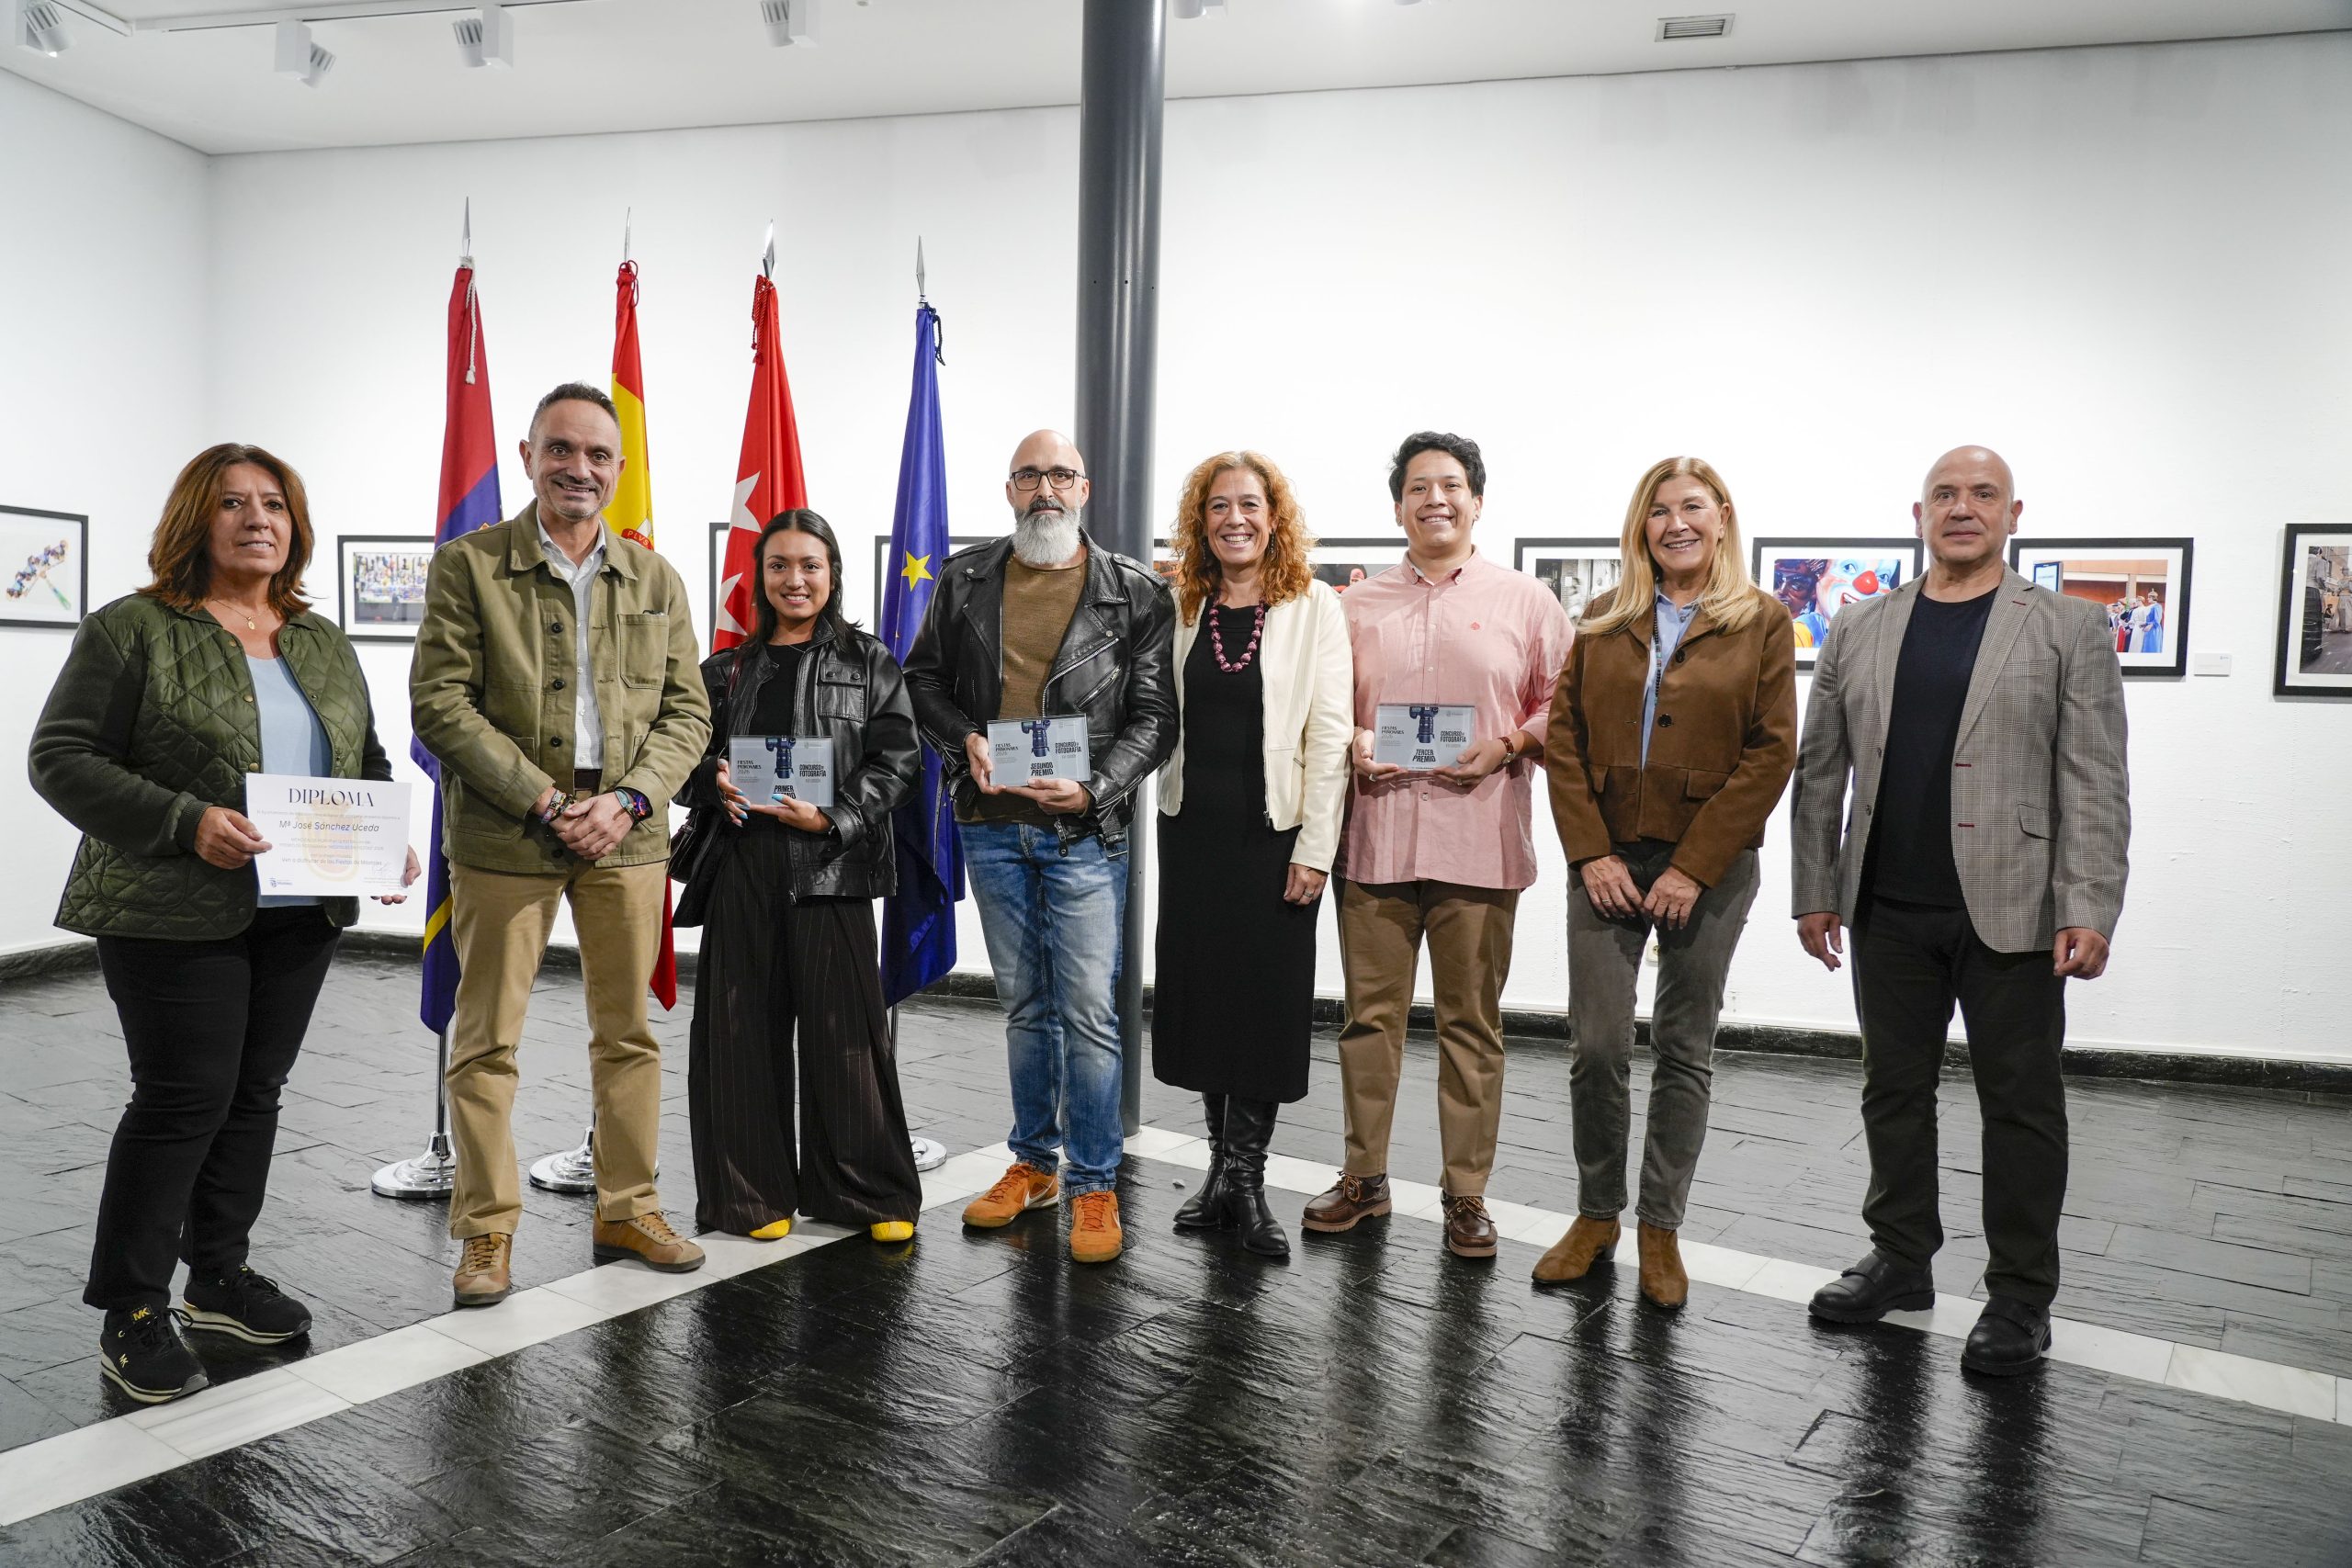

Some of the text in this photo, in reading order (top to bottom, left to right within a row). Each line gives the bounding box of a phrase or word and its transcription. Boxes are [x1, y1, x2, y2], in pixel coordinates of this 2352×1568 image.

[628, 530, 649, 546] PLVS
[288, 788, 374, 807] DIPLOMA
[292, 821, 312, 829] José
[314, 821, 350, 831] Sánchez
[352, 823, 379, 832] Uceda
[132, 1307, 150, 1321] MK
